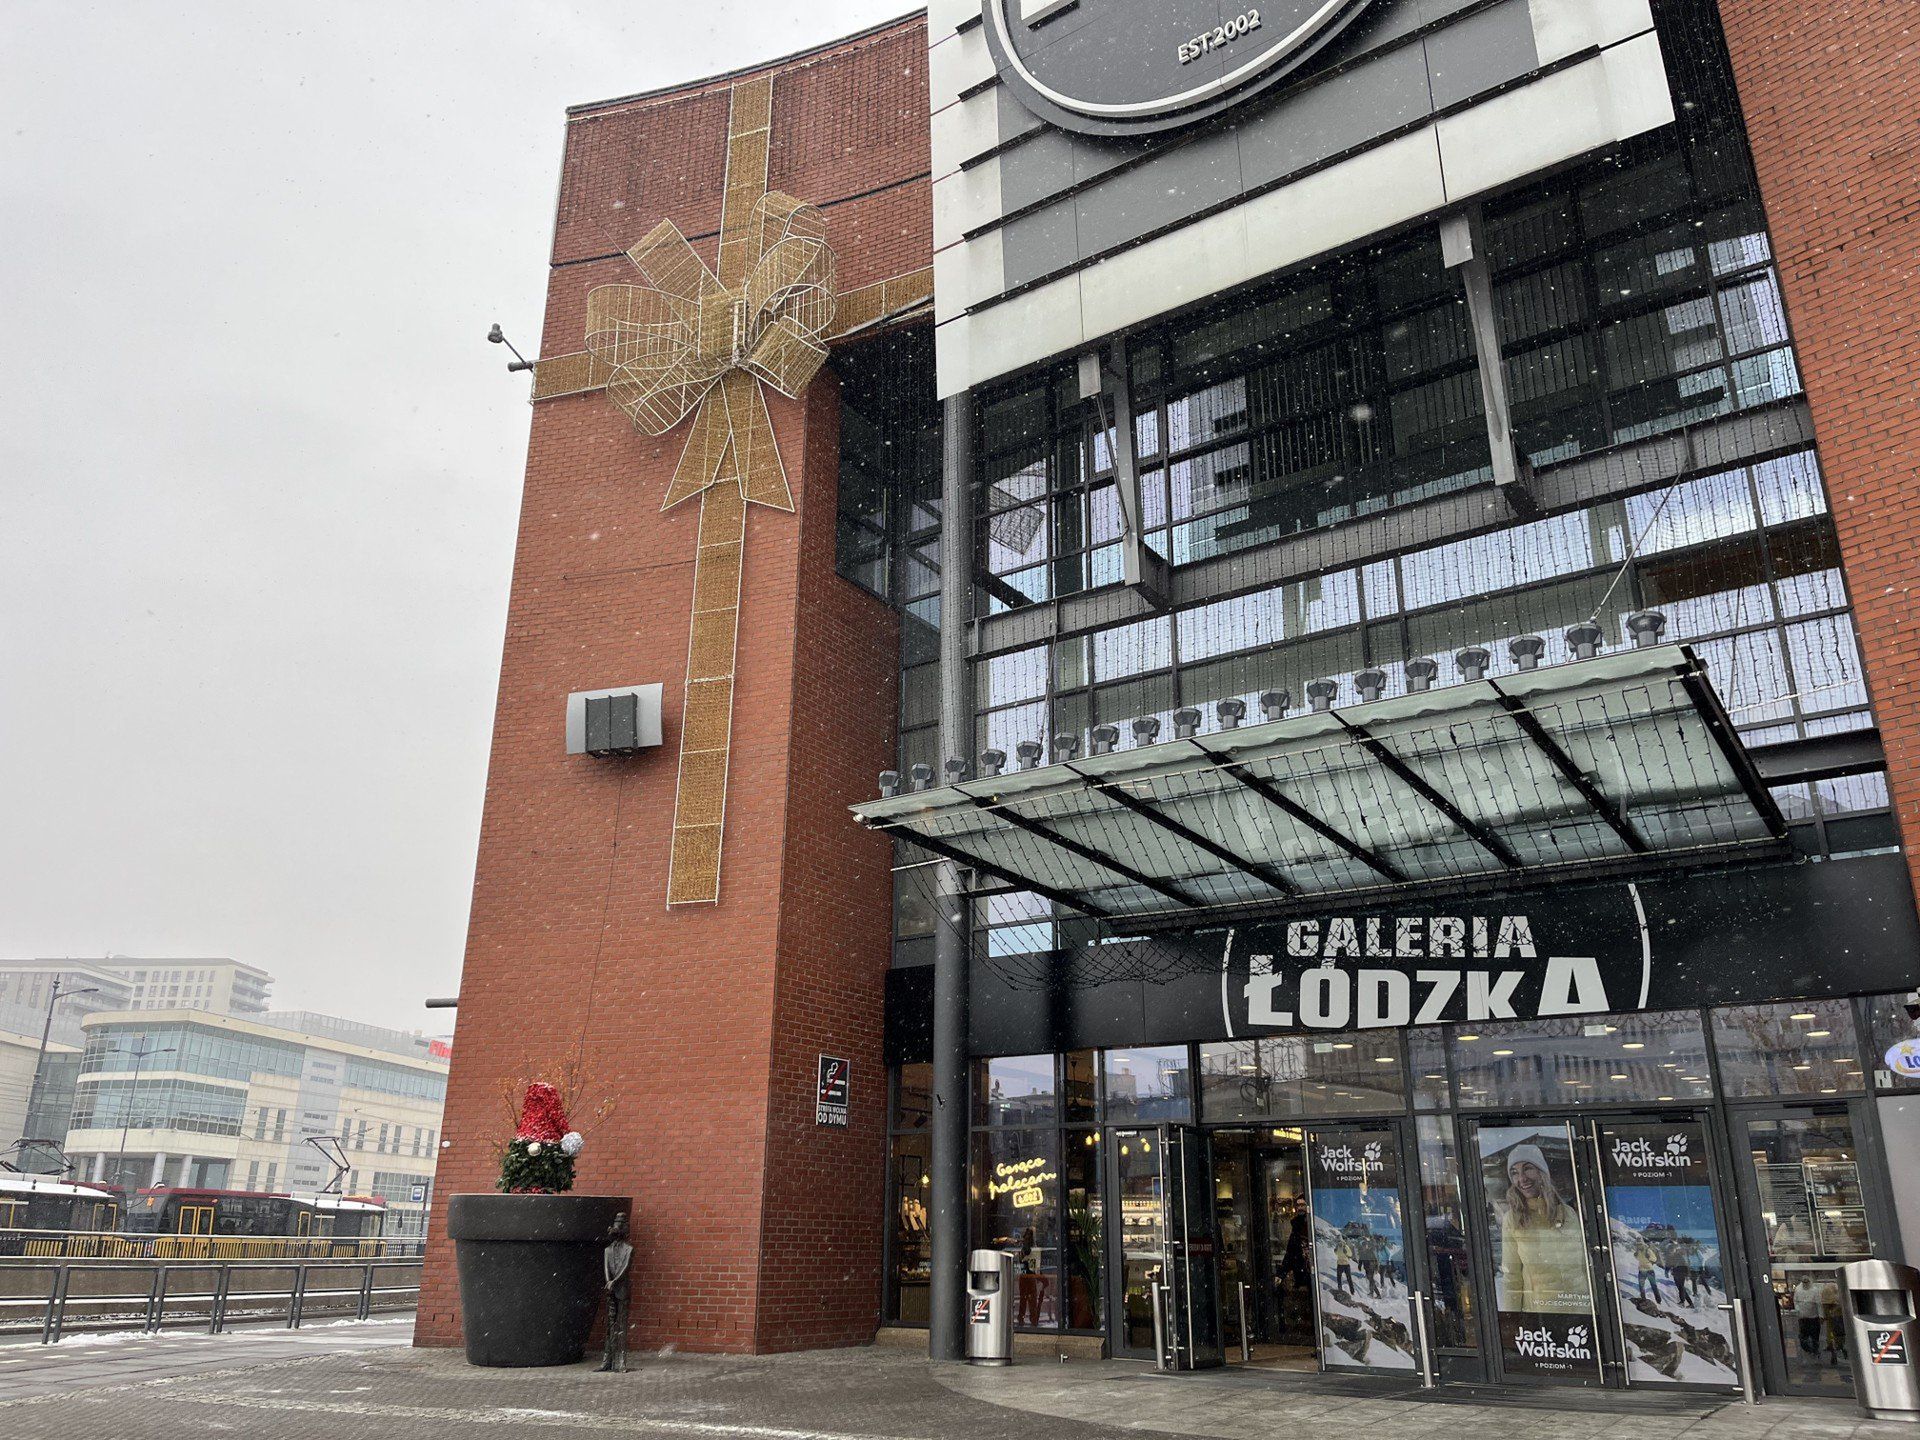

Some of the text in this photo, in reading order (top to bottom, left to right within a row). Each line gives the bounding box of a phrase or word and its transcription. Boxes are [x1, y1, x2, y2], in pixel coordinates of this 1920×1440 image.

[1178, 9, 1261, 64] EST.2002
[1286, 915, 1538, 958] GALERIA
[1244, 954, 1611, 1029] ŁÓDZKA
[818, 1112, 847, 1126] OD DYMU
[1320, 1145, 1352, 1158] Jack
[1612, 1137, 1651, 1152] Jack
[1320, 1158, 1383, 1171] Wolfskin
[1612, 1152, 1691, 1167] Wolfskin
[1515, 1326, 1553, 1342] Jack
[1515, 1340, 1591, 1359] Wolfskin
